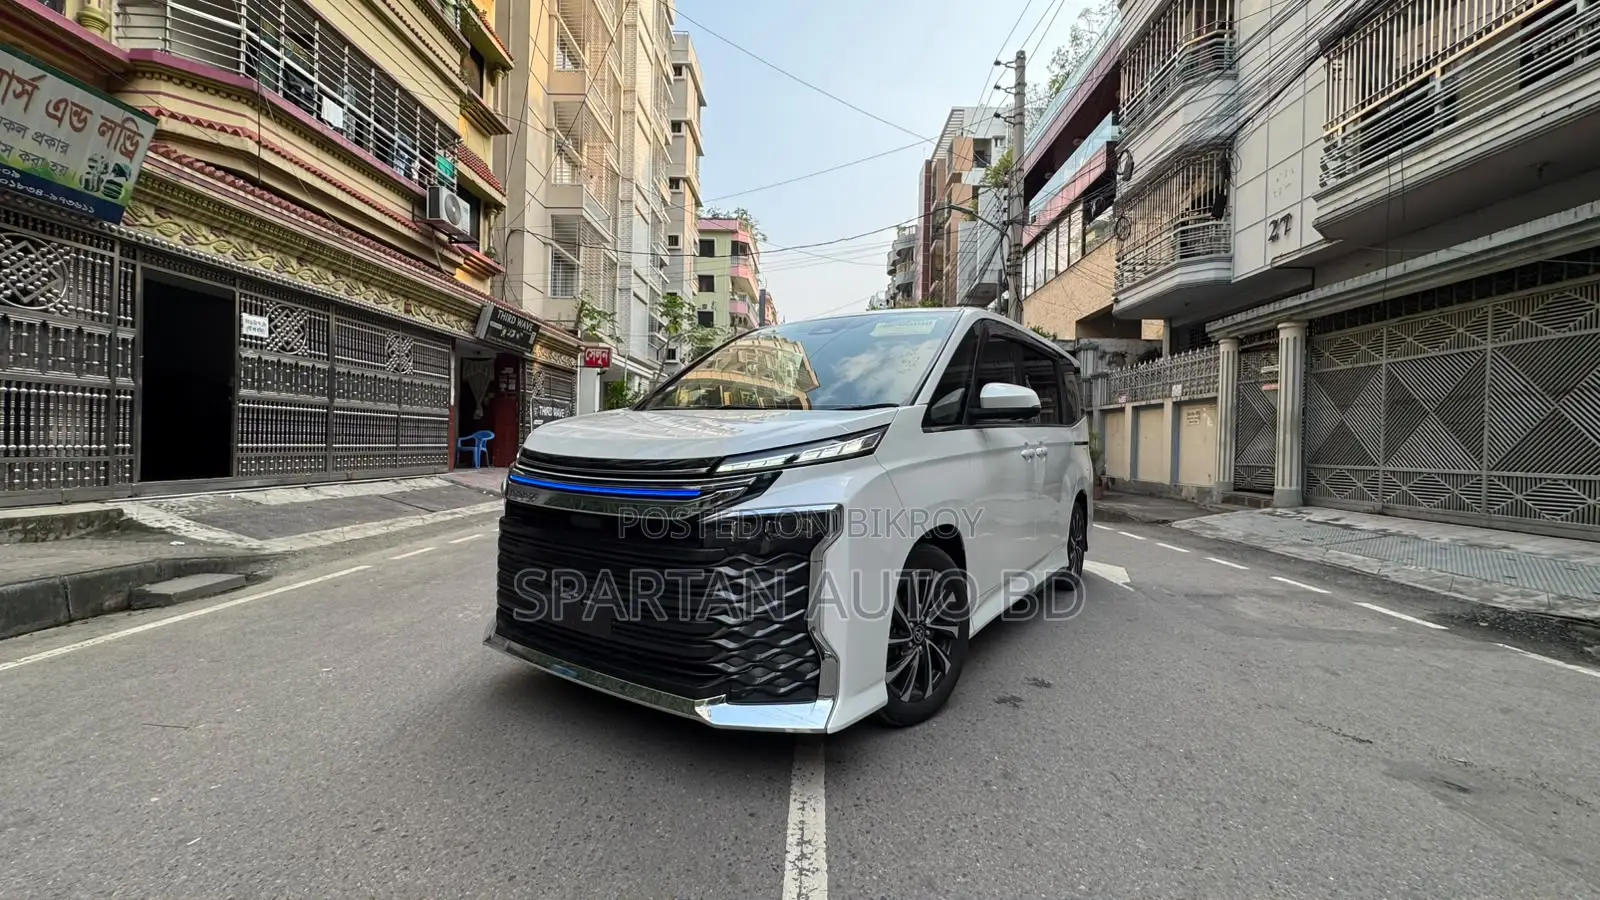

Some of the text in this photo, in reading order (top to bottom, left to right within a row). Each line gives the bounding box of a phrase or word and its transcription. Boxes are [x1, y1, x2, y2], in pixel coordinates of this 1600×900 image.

[32, 131, 71, 156] প্রকার
[1267, 212, 1293, 242] 27
[497, 309, 517, 325] THIRD
[516, 317, 534, 332] WAVE
